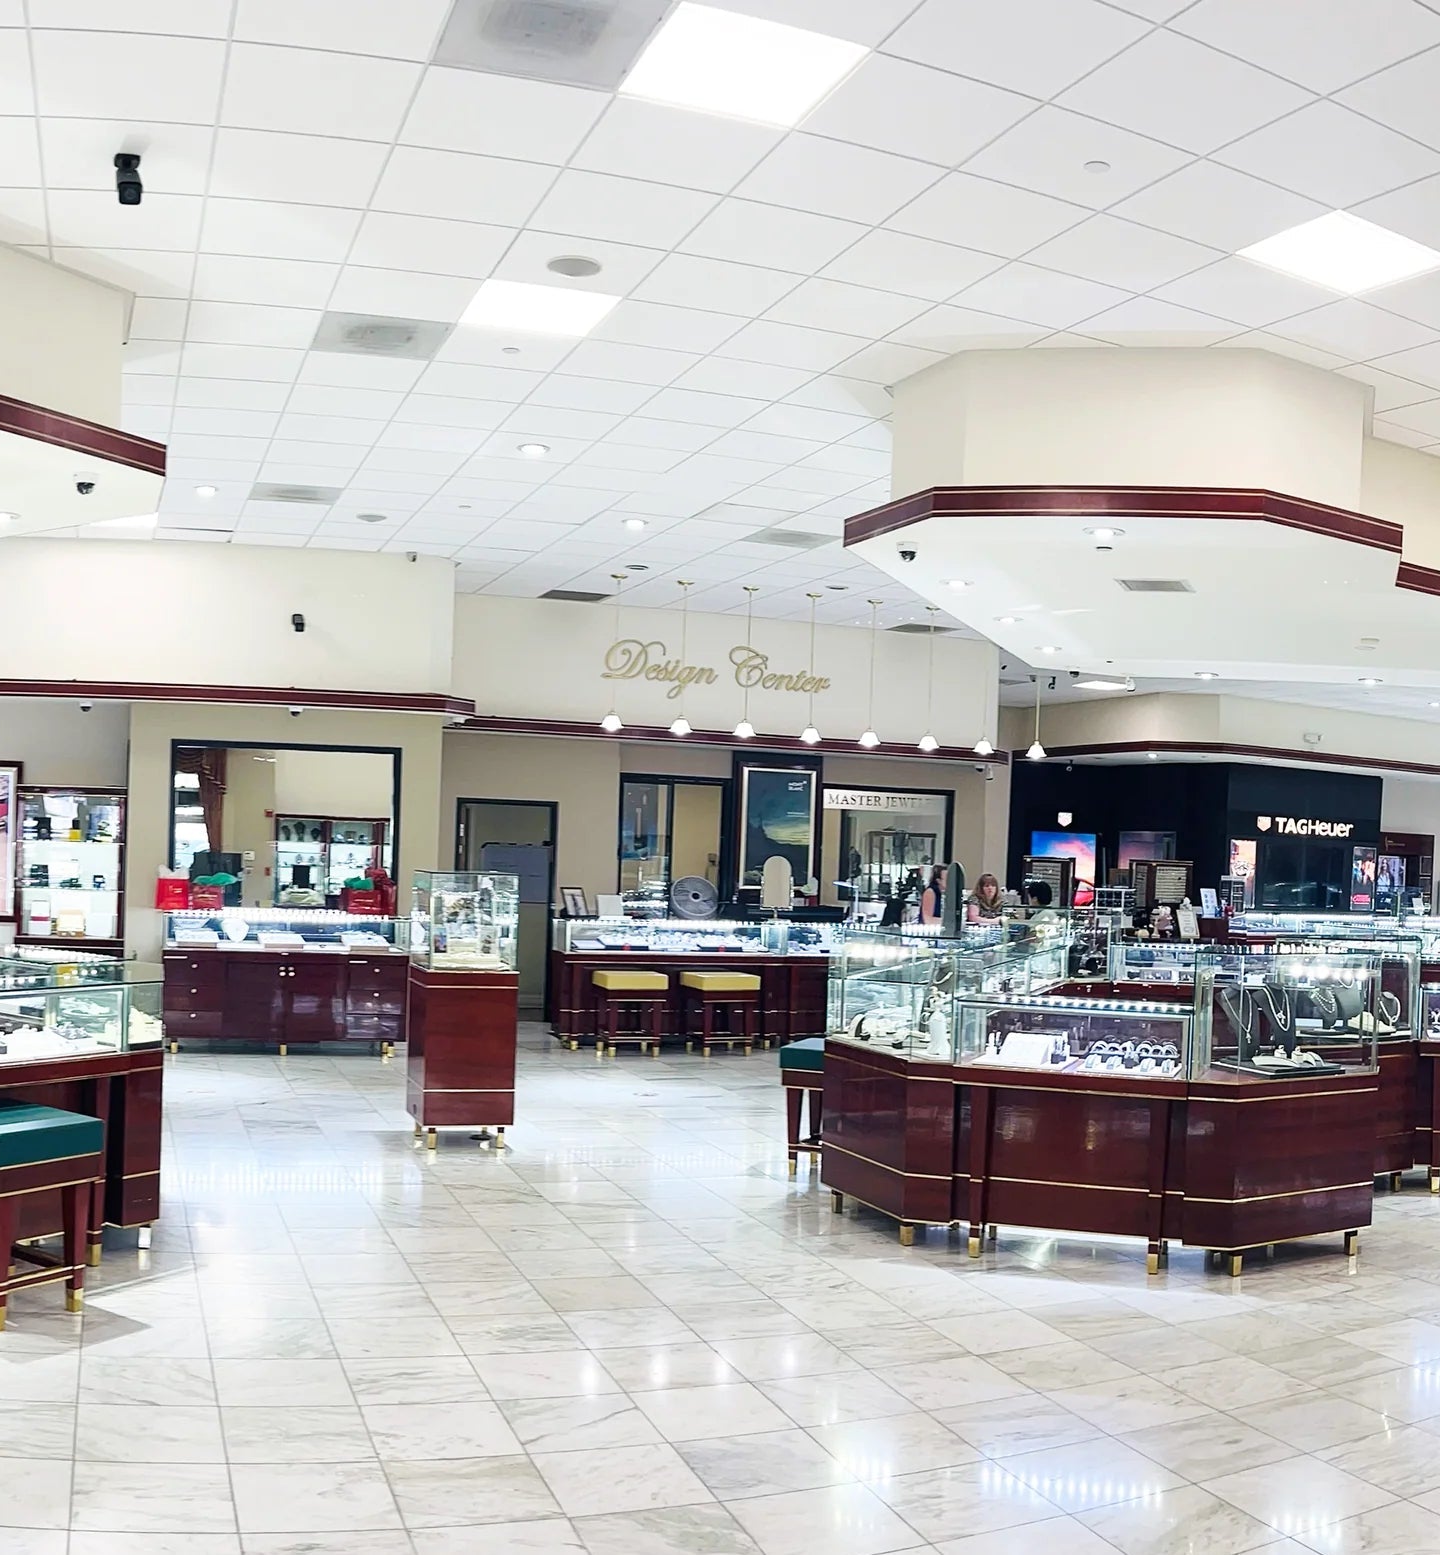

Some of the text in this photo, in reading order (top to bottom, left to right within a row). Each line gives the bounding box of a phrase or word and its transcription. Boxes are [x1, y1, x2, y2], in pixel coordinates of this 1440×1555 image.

[600, 640, 831, 699] Design Center
[828, 793, 882, 807] MASTER
